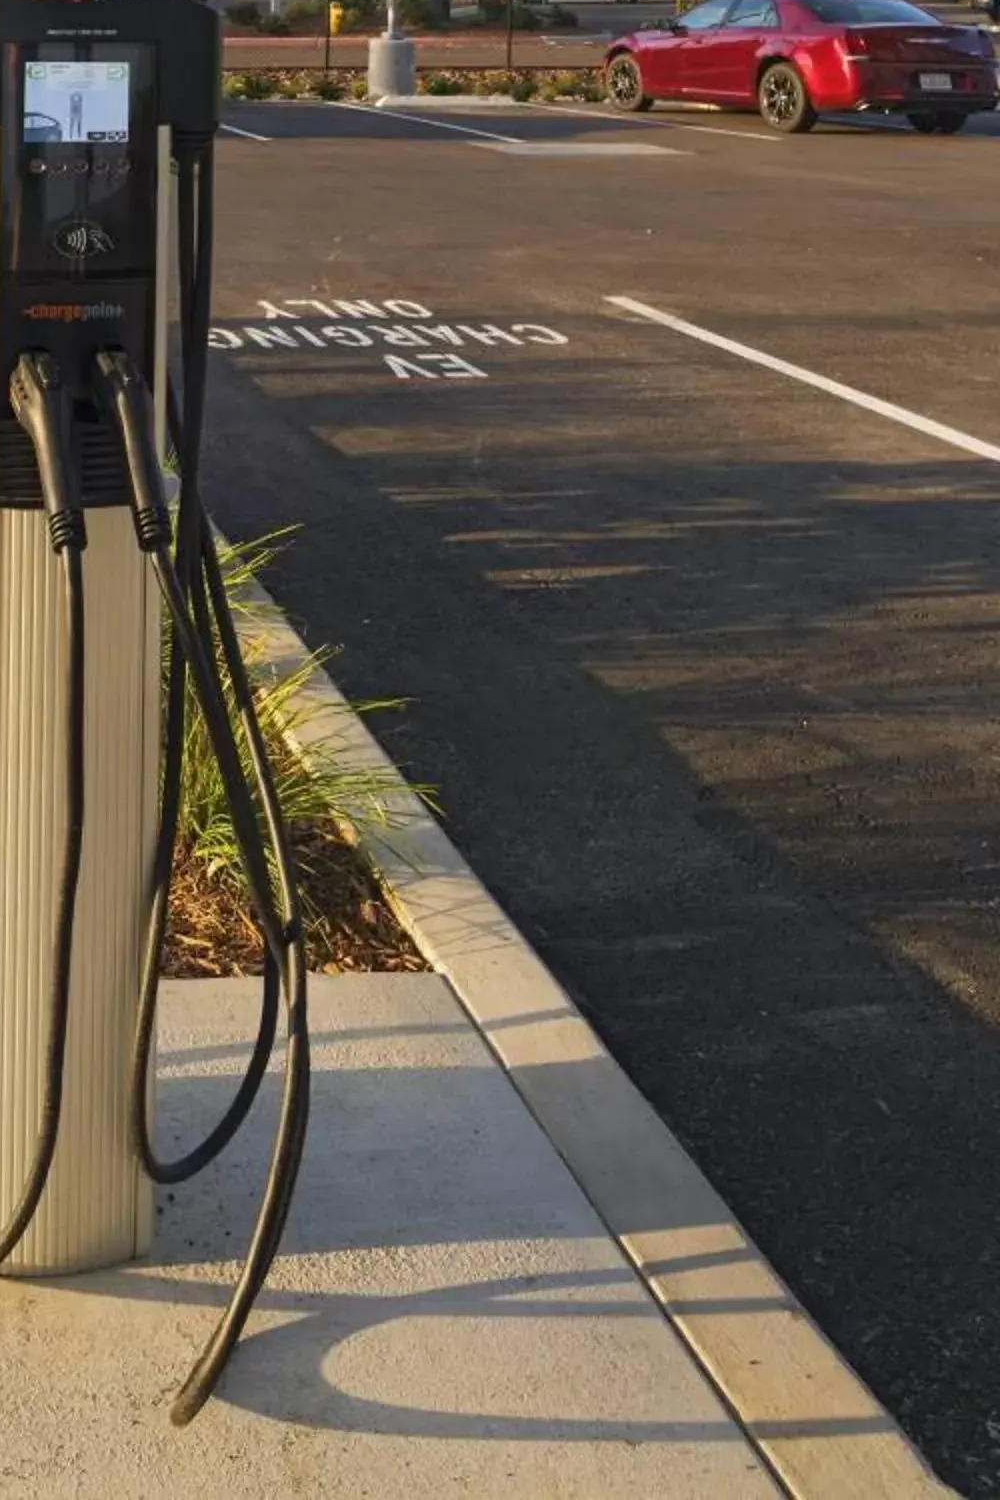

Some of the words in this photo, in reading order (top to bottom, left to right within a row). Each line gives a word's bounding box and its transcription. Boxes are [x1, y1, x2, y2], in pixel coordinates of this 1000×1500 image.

[257, 299, 433, 319] ONLY
[207, 323, 569, 350] CHARGING
[383, 352, 489, 379] EV
